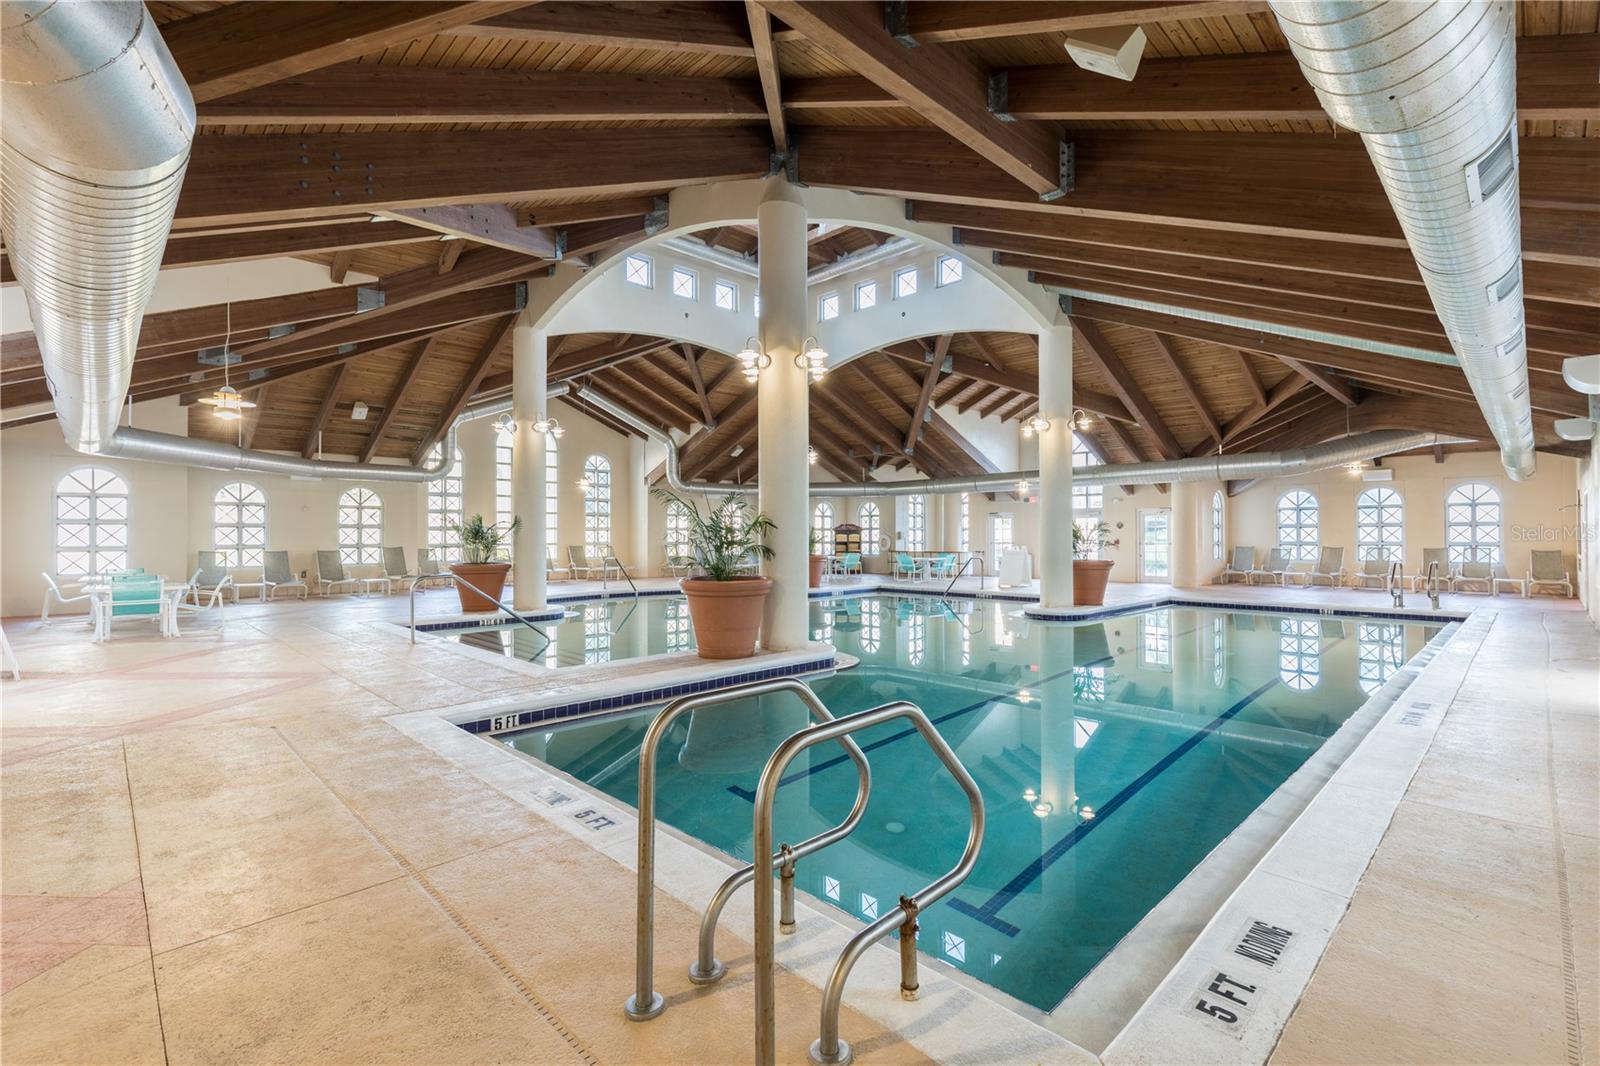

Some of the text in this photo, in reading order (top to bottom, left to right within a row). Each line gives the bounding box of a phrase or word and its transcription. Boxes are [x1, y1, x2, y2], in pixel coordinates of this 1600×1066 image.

[494, 717, 503, 730] 5
[574, 810, 597, 819] 5
[1233, 921, 1293, 967] NO DIVING
[1195, 972, 1256, 1023] 5 FT.
